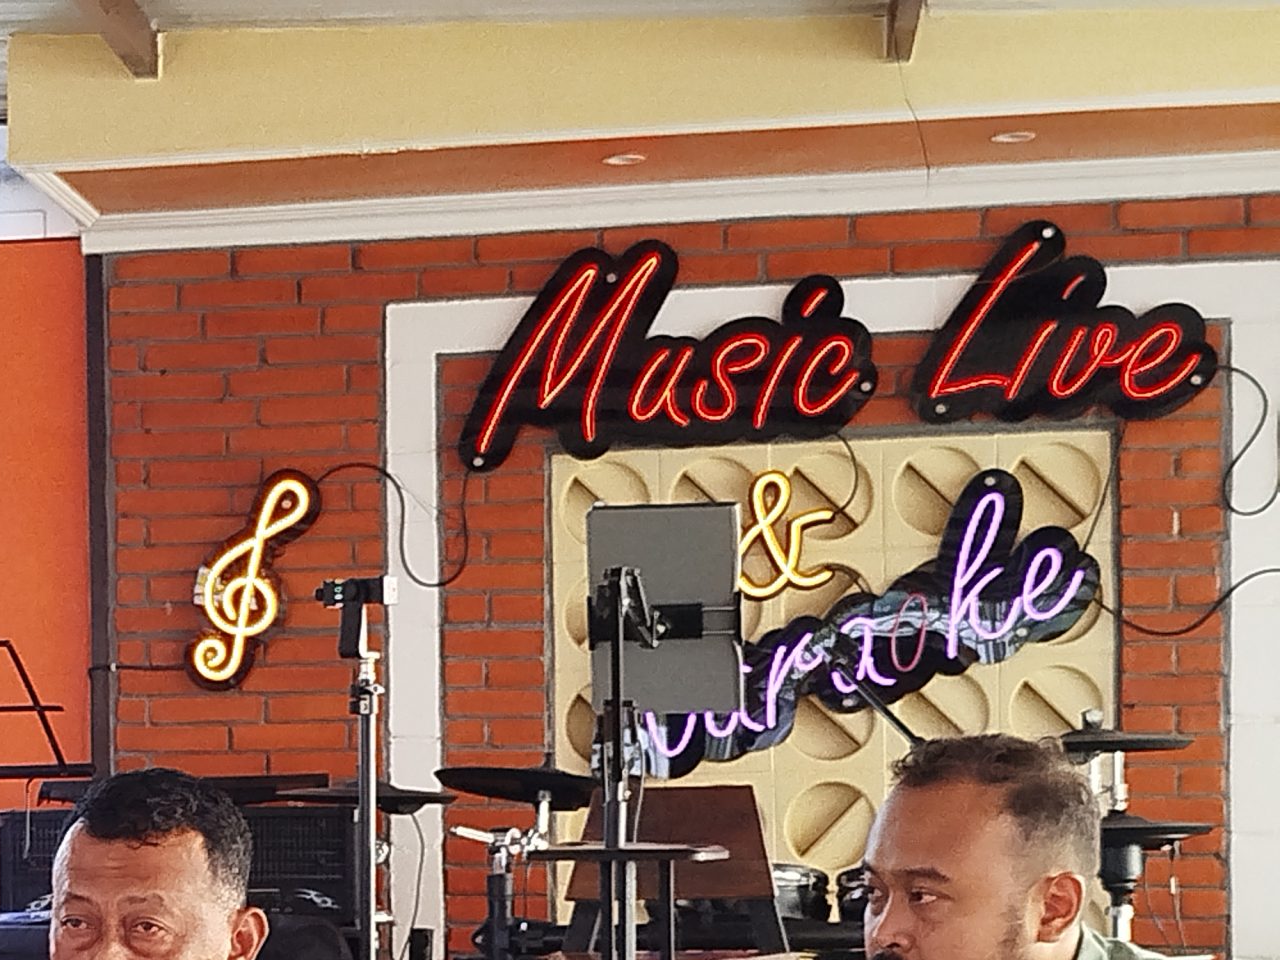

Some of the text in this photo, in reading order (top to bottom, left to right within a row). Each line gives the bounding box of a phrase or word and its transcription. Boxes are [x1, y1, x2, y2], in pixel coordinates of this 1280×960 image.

[476, 239, 1202, 455] Music Live
[644, 491, 1086, 758] raoke
[738, 469, 836, 600] &
